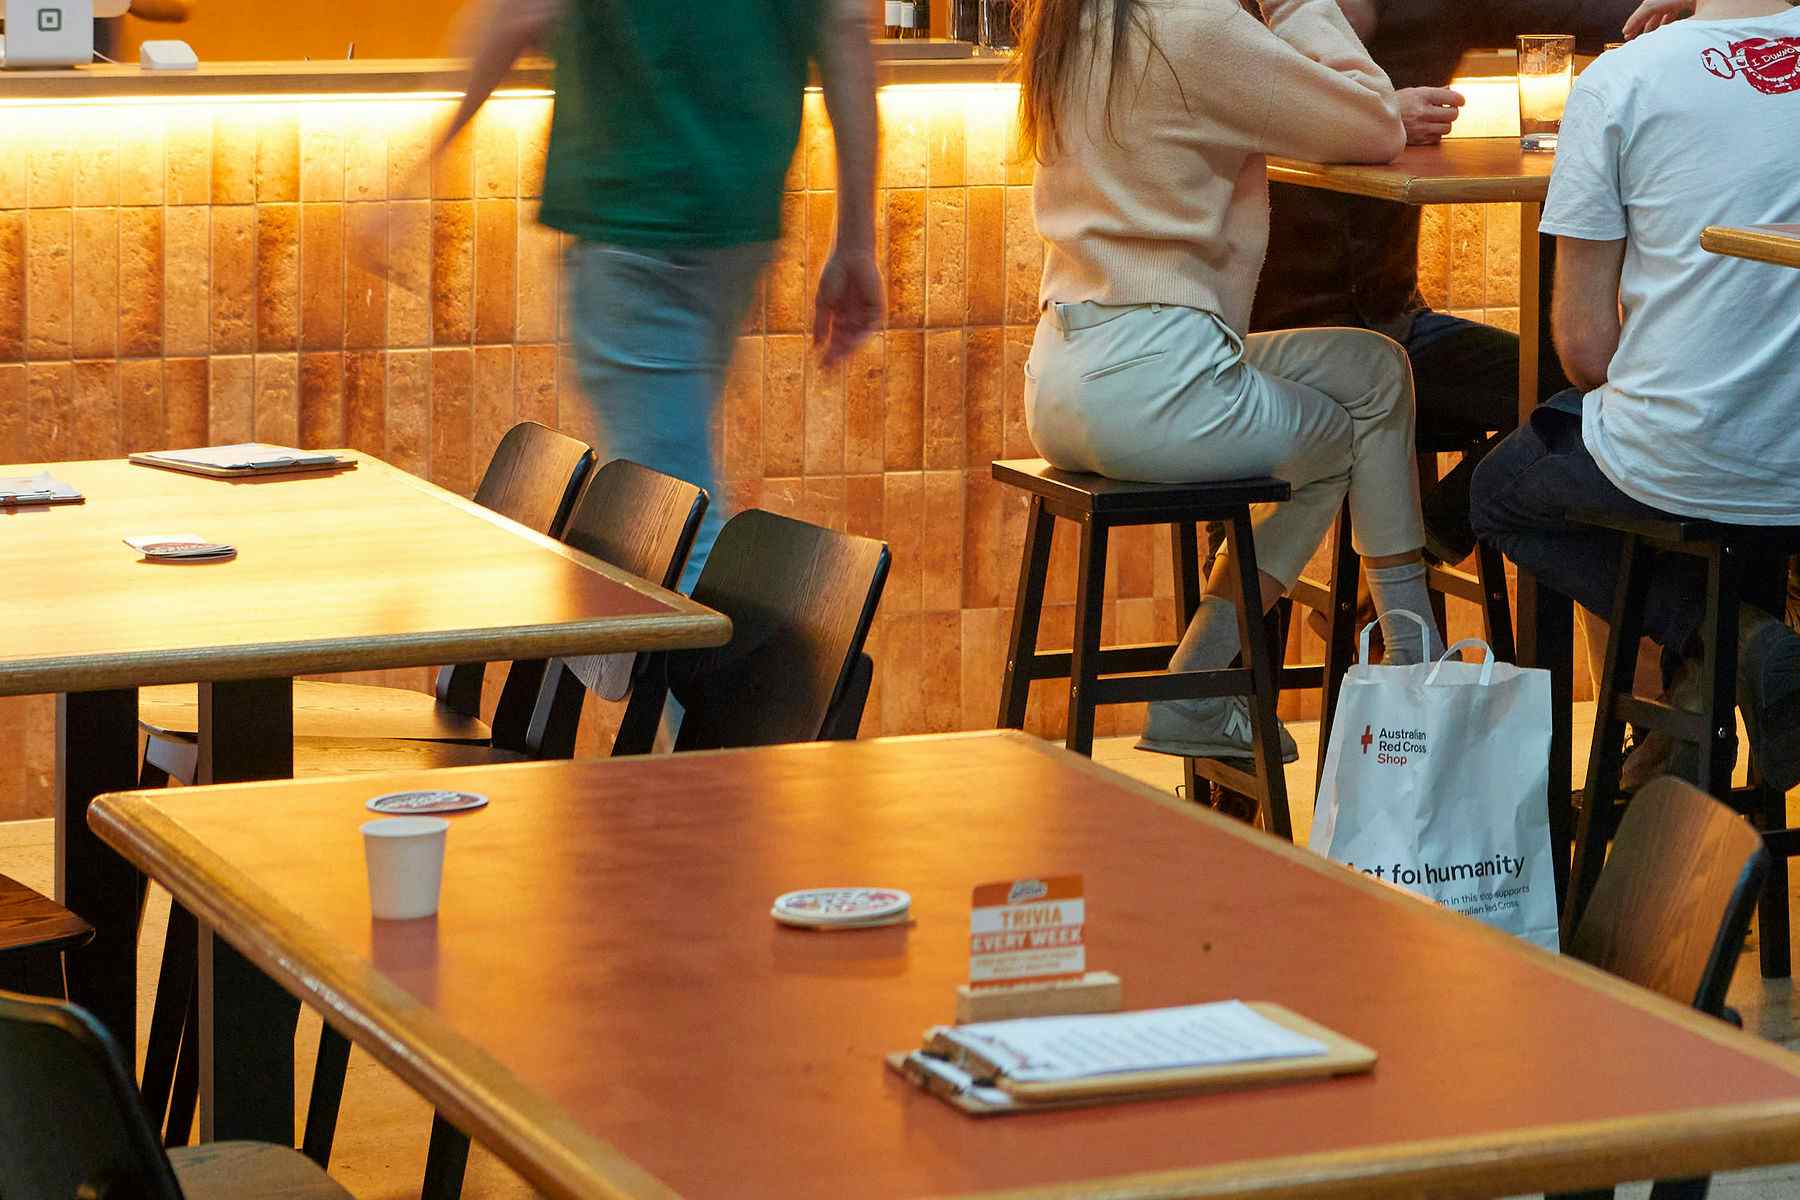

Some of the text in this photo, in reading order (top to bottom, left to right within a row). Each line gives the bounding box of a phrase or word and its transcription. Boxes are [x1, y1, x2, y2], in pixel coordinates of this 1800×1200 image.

[1761, 47, 1795, 63] DUNNO
[1379, 728, 1427, 740] Australian
[1379, 741, 1427, 754] Red Cross
[1377, 753, 1408, 766] Shop
[1424, 854, 1525, 884] humanity
[1462, 892, 1478, 903] this
[1494, 885, 1530, 900] supports
[1000, 907, 1062, 930] TRIVIA
[972, 928, 1083, 951] EVERY WEEK
